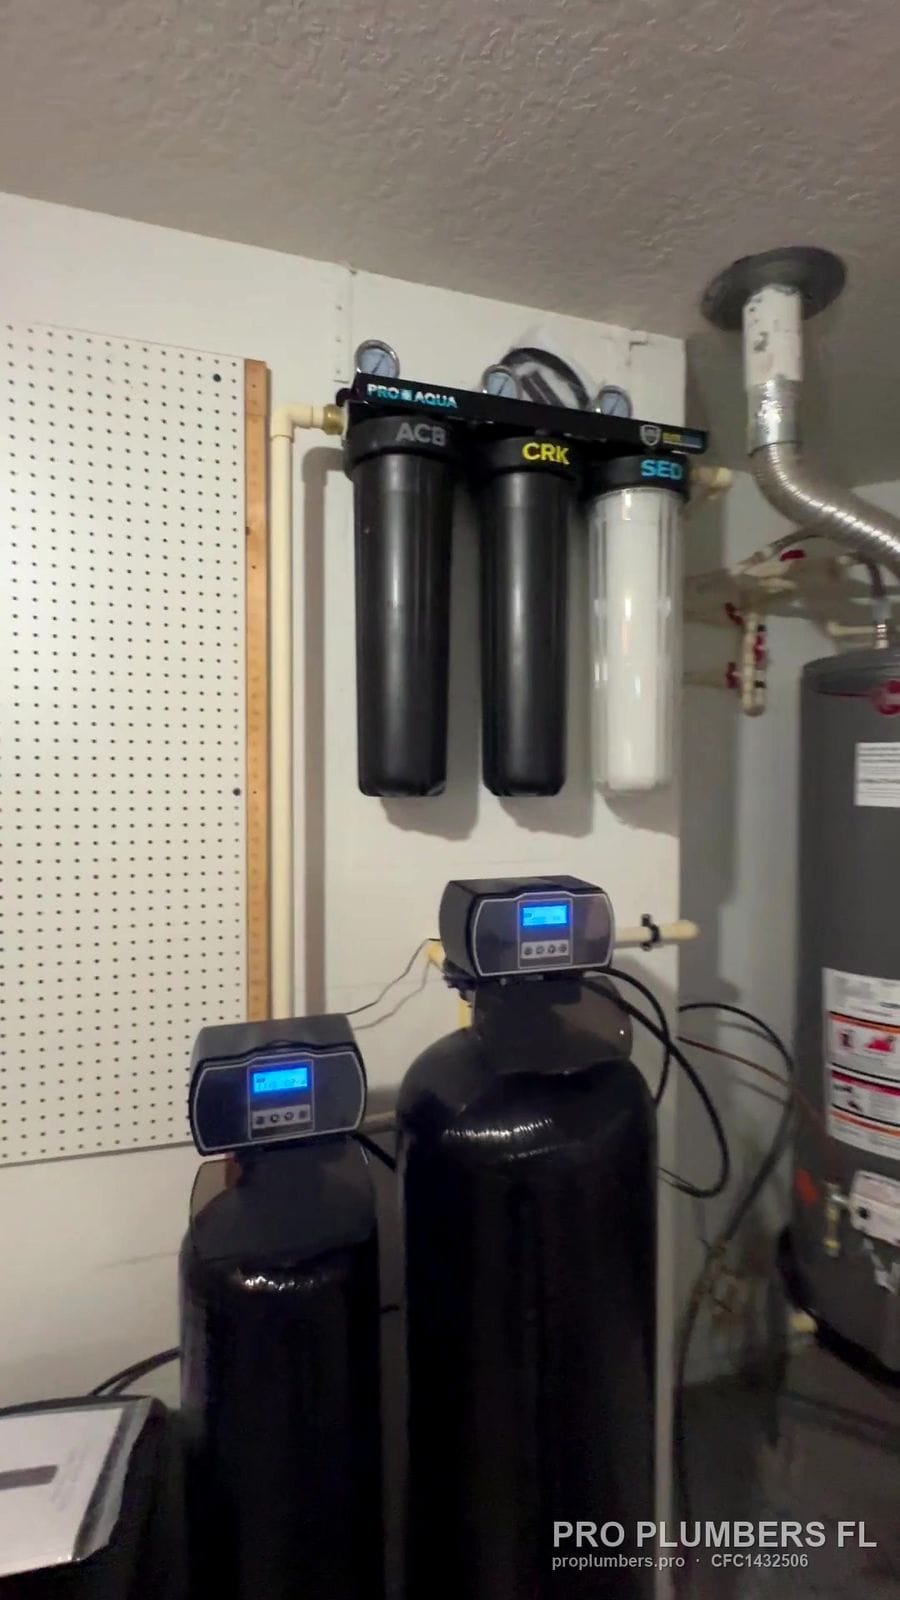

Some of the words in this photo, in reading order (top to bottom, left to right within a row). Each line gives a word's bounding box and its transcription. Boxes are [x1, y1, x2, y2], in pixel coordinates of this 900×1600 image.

[366, 383, 400, 400] PRO
[414, 391, 458, 409] AQUA
[395, 422, 446, 447] ACB
[522, 442, 570, 465] CRK
[640, 459, 683, 480] SED
